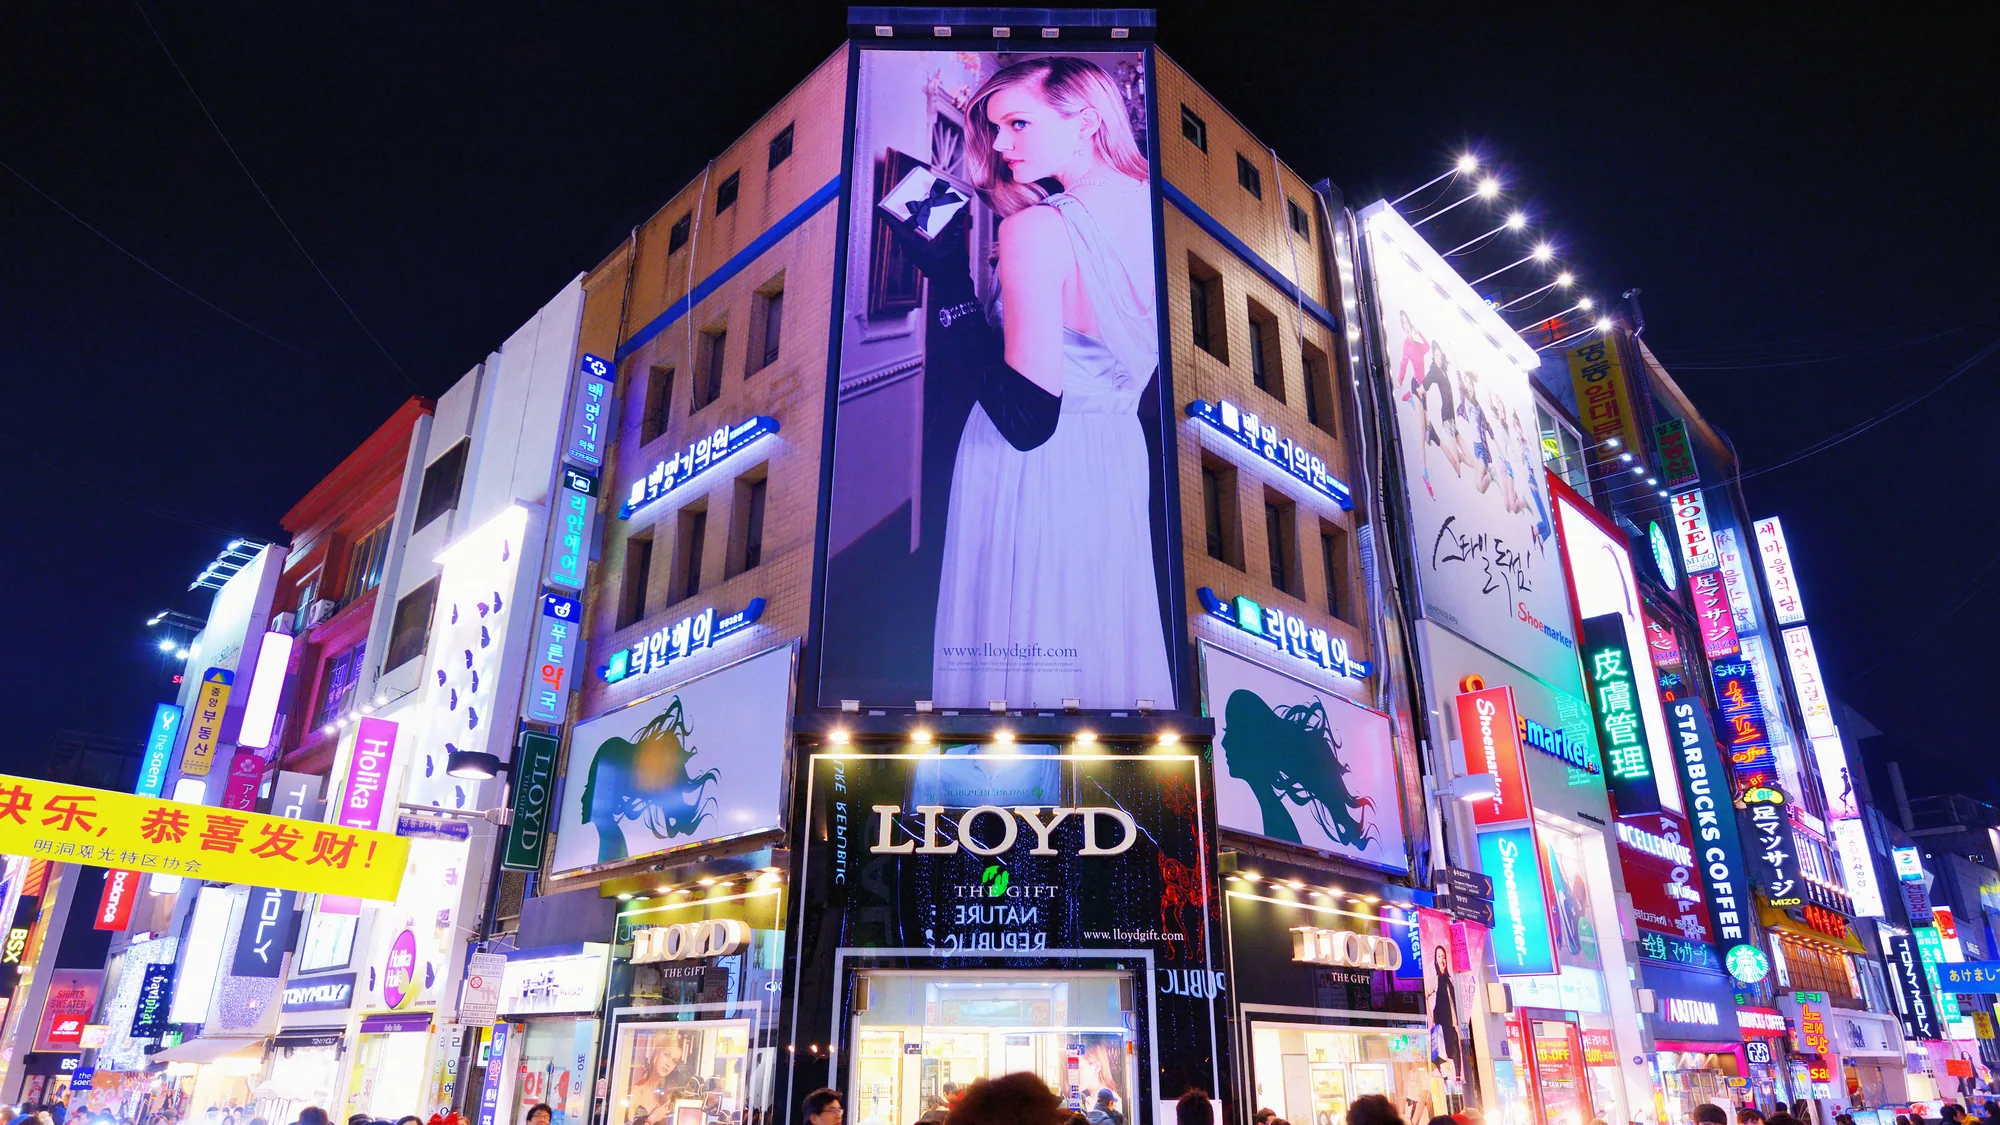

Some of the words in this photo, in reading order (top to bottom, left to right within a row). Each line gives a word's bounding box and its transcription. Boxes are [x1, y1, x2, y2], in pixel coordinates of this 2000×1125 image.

[583, 382, 604, 441] 백명기
[647, 425, 730, 500] 백명기의원
[1241, 412, 1327, 491] 백명기의원
[559, 495, 588, 576] 리안헤어
[1677, 493, 1709, 558] HOTEL
[1686, 553, 1715, 566] MIZO
[1758, 521, 1796, 612] 새마을식당
[1517, 601, 1573, 649] Shoemarker
[1696, 573, 1731, 641] 足マッサージ
[629, 607, 713, 673] 리안헤어
[942, 643, 1078, 660] www.lloydgift.com
[1266, 607, 1351, 677] 리안헤어
[1706, 638, 1738, 651] MIZO
[540, 620, 568, 712] 푸른약국
[1715, 664, 1747, 677] Sky
[1594, 647, 1650, 779] 皮膚管理
[156, 733, 168, 752] the
[1732, 745, 1768, 763] Coffee
[144, 751, 165, 789] saem
[350, 738, 389, 809] Holika
[520, 751, 551, 851] LLOYD
[1674, 703, 1722, 841] STARBUCKS
[1705, 847, 1743, 940] COFFEE
[869, 804, 1138, 857] LLOYD
[1752, 804, 1796, 898] 足マッサージ
[33, 838, 203, 874] 明洞观光特区协会
[103, 870, 130, 924] balance
[953, 885, 1000, 899] THE
[1005, 885, 1059, 899] GIFT
[1497, 836, 1527, 958] Shoemarker
[1770, 897, 1801, 907] MIZO
[3, 928, 29, 964] BSX
[630, 919, 746, 965] LLOYD
[1082, 927, 1185, 944] www.lloydgift.com
[1289, 925, 1402, 971] LLOYD
[56, 990, 85, 999] SHIRTS
[663, 967, 683, 978] THE
[684, 965, 707, 976] GIFT
[1331, 972, 1349, 983] THE
[1350, 973, 1371, 985] GIFT
[1898, 938, 1932, 1038] TONYMOLY
[50, 1000, 87, 1009] SWEATER
[141, 975, 165, 1026] baviphat
[1669, 998, 1719, 1025] ARITAUM
[1802, 1003, 1830, 1055] 노래방
[78, 1072, 92, 1080] the
